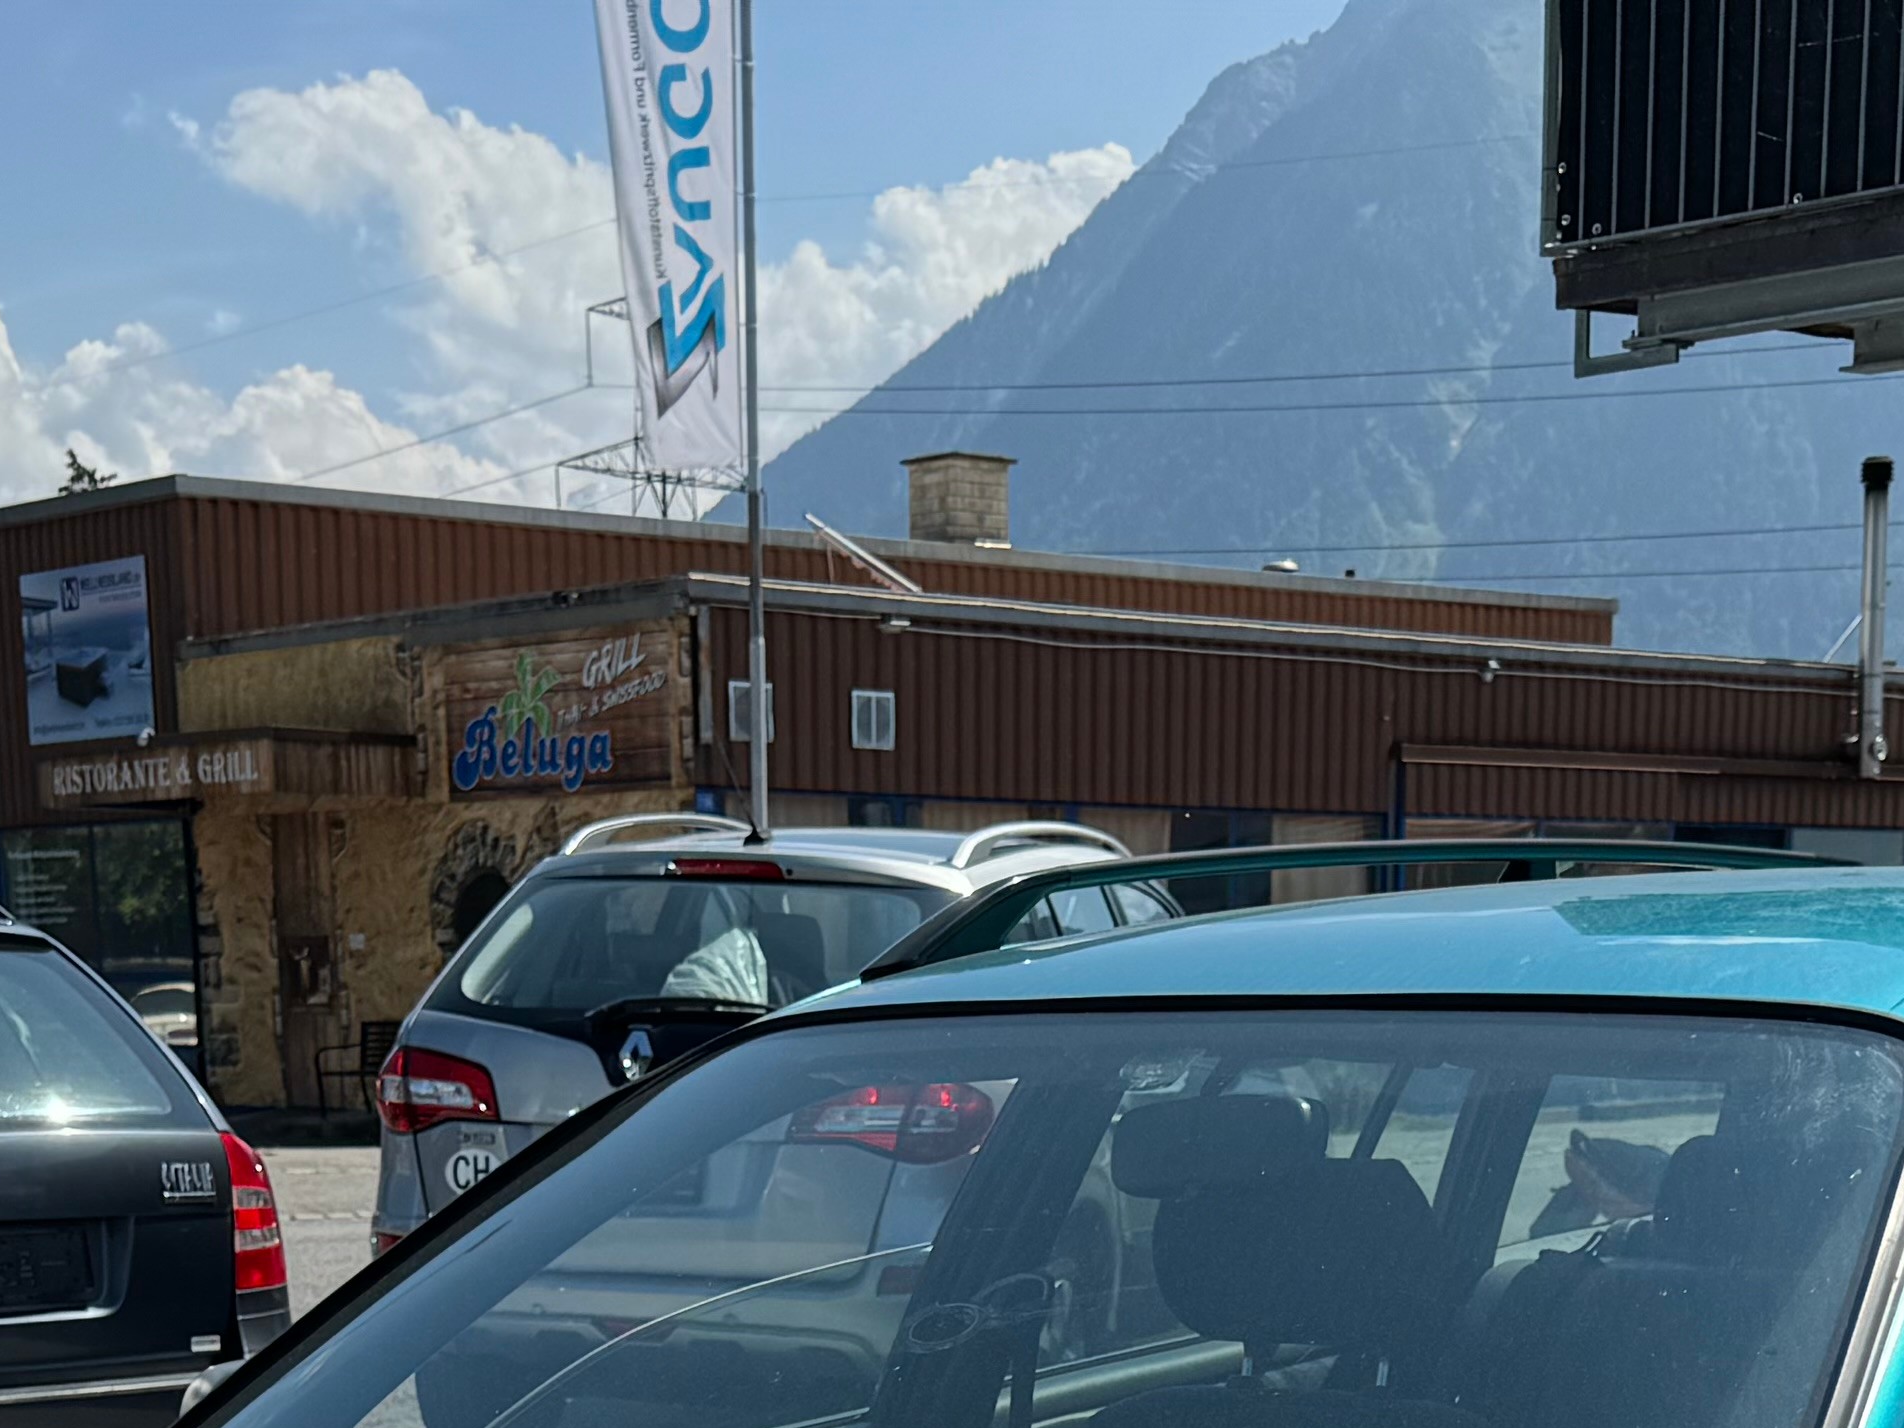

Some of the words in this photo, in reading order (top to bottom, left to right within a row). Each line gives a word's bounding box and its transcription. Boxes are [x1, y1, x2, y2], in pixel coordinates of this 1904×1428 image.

[582, 633, 646, 690] GRILL
[53, 757, 171, 796] RISTORANTE
[175, 755, 193, 785] &
[197, 751, 259, 784] GRILL
[453, 706, 614, 793] Beluga
[452, 1154, 490, 1190] CH
